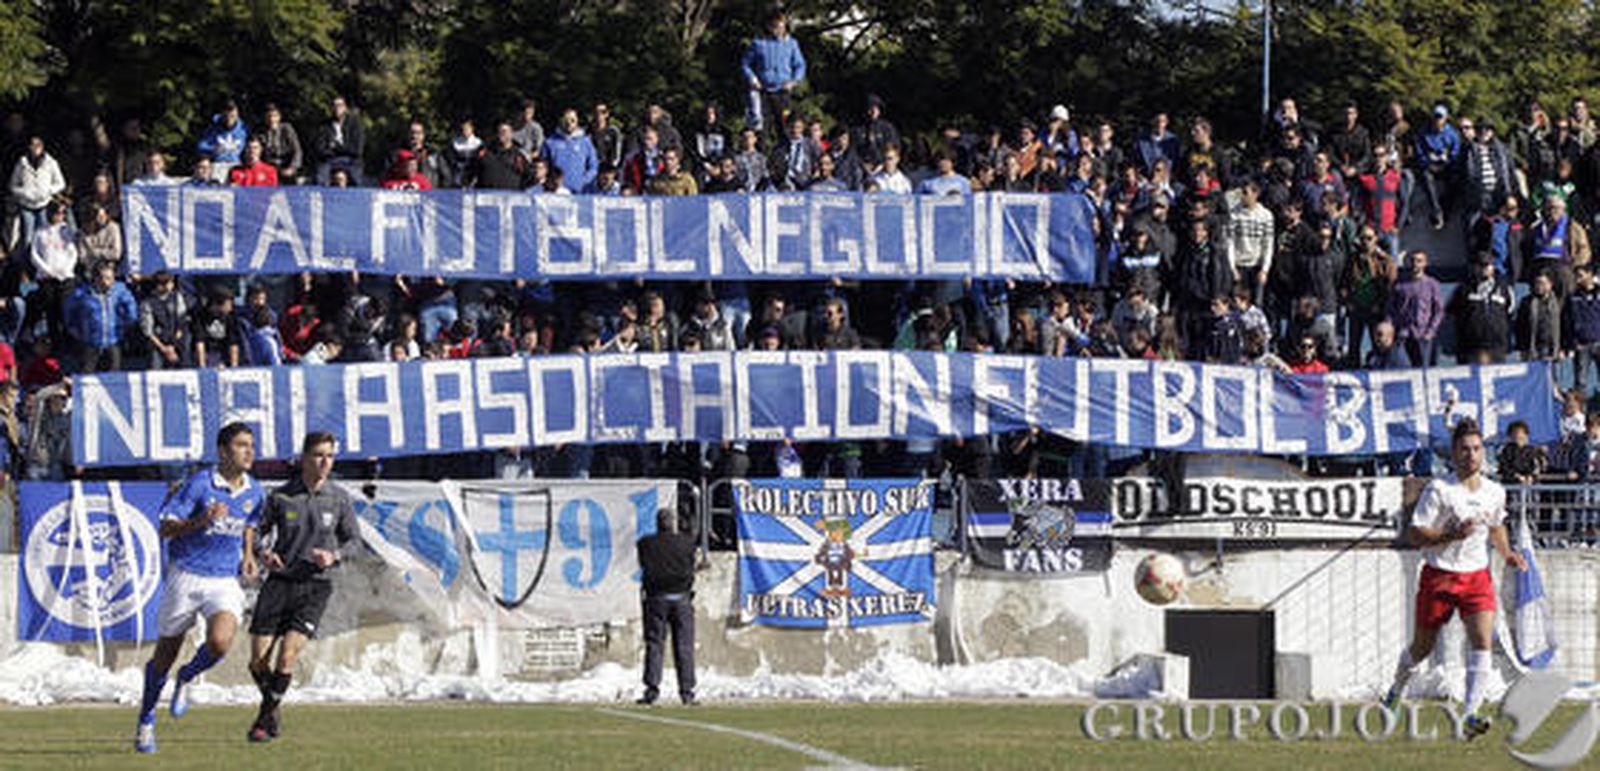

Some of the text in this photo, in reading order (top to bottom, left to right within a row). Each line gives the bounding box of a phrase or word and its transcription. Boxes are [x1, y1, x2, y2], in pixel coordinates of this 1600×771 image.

[126, 190, 1053, 278] NO AL FUTBOL NEGOCIO
[81, 370, 203, 462] NO
[421, 350, 951, 450] ASOCIACION
[973, 353, 1307, 453] FUTBOL
[739, 484, 930, 516] KOLECTIVO SUR
[998, 478, 1083, 501] XERA
[1005, 549, 1083, 572] FANS
